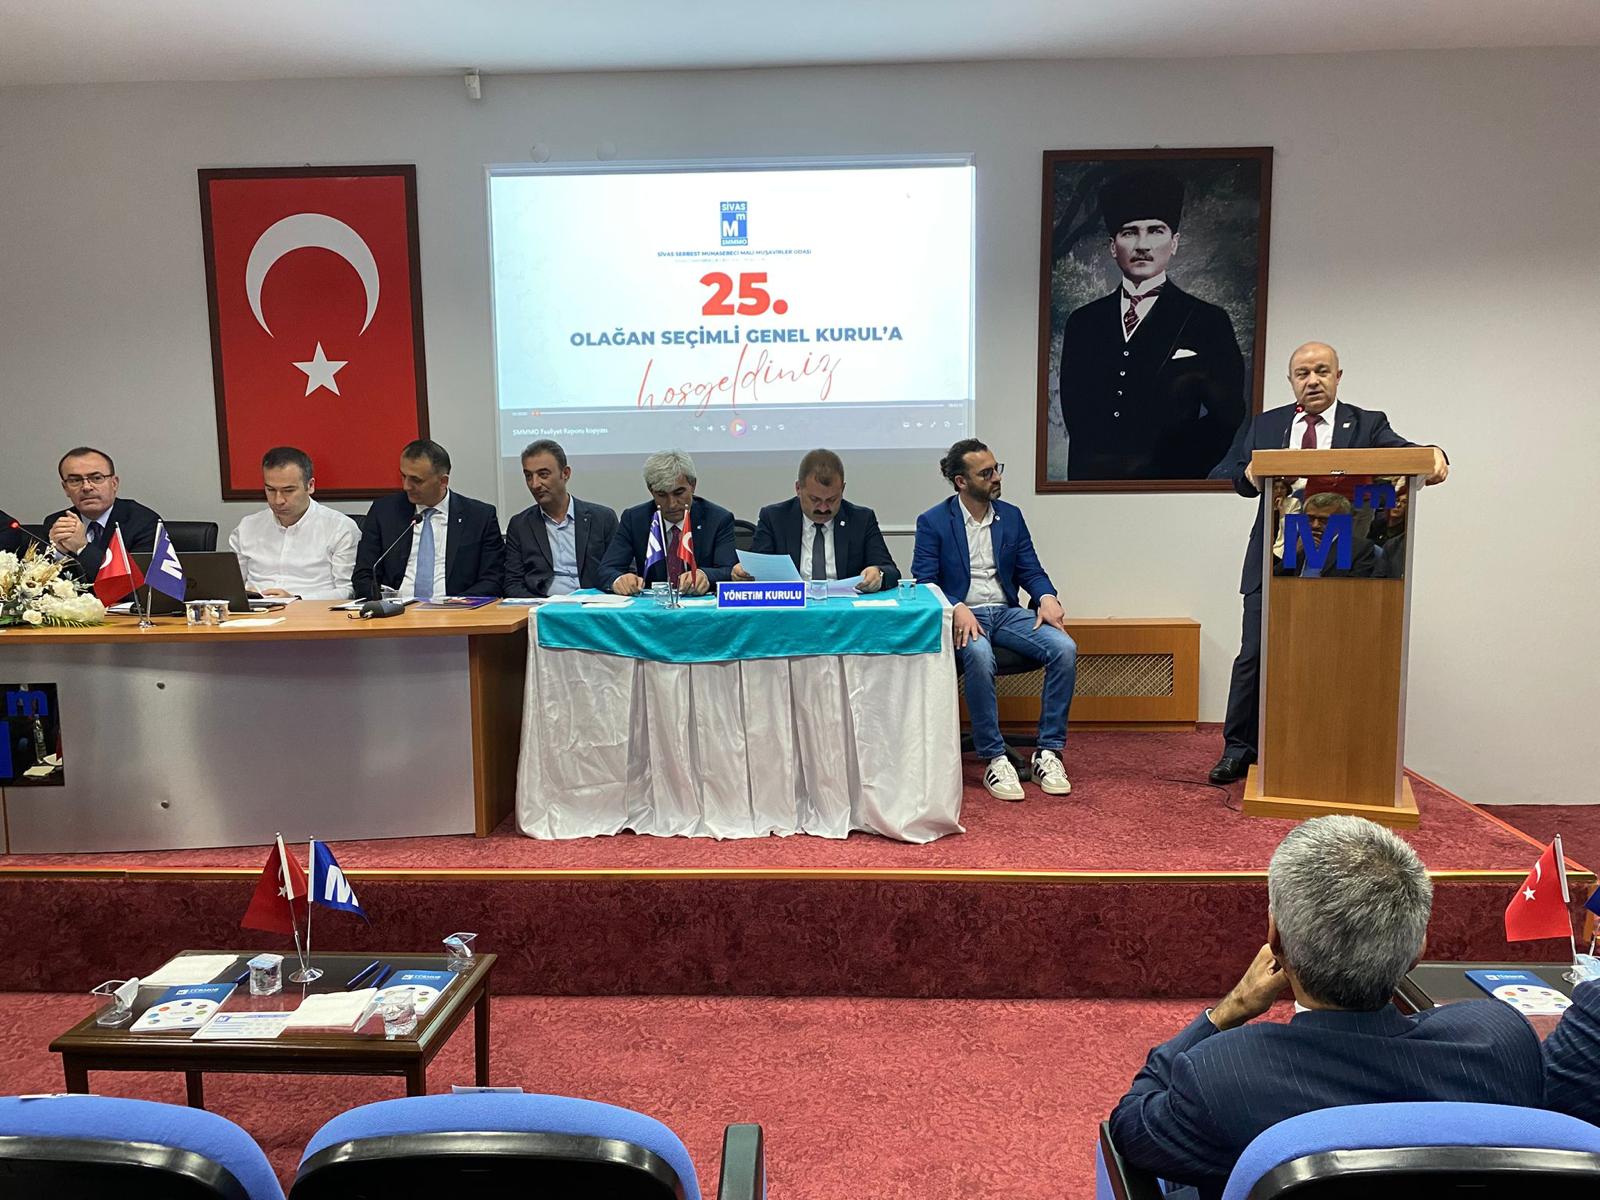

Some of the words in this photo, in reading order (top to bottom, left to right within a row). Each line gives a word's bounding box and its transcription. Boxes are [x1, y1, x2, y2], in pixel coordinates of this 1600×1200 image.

[721, 202, 746, 211] SİVAS
[699, 272, 788, 316] 25.
[570, 328, 655, 346] OLAĞAN
[661, 325, 739, 349] SEÇİMLİ
[746, 329, 810, 343] GENEL
[1283, 513, 1354, 569] M
[765, 590, 802, 600] KURULU
